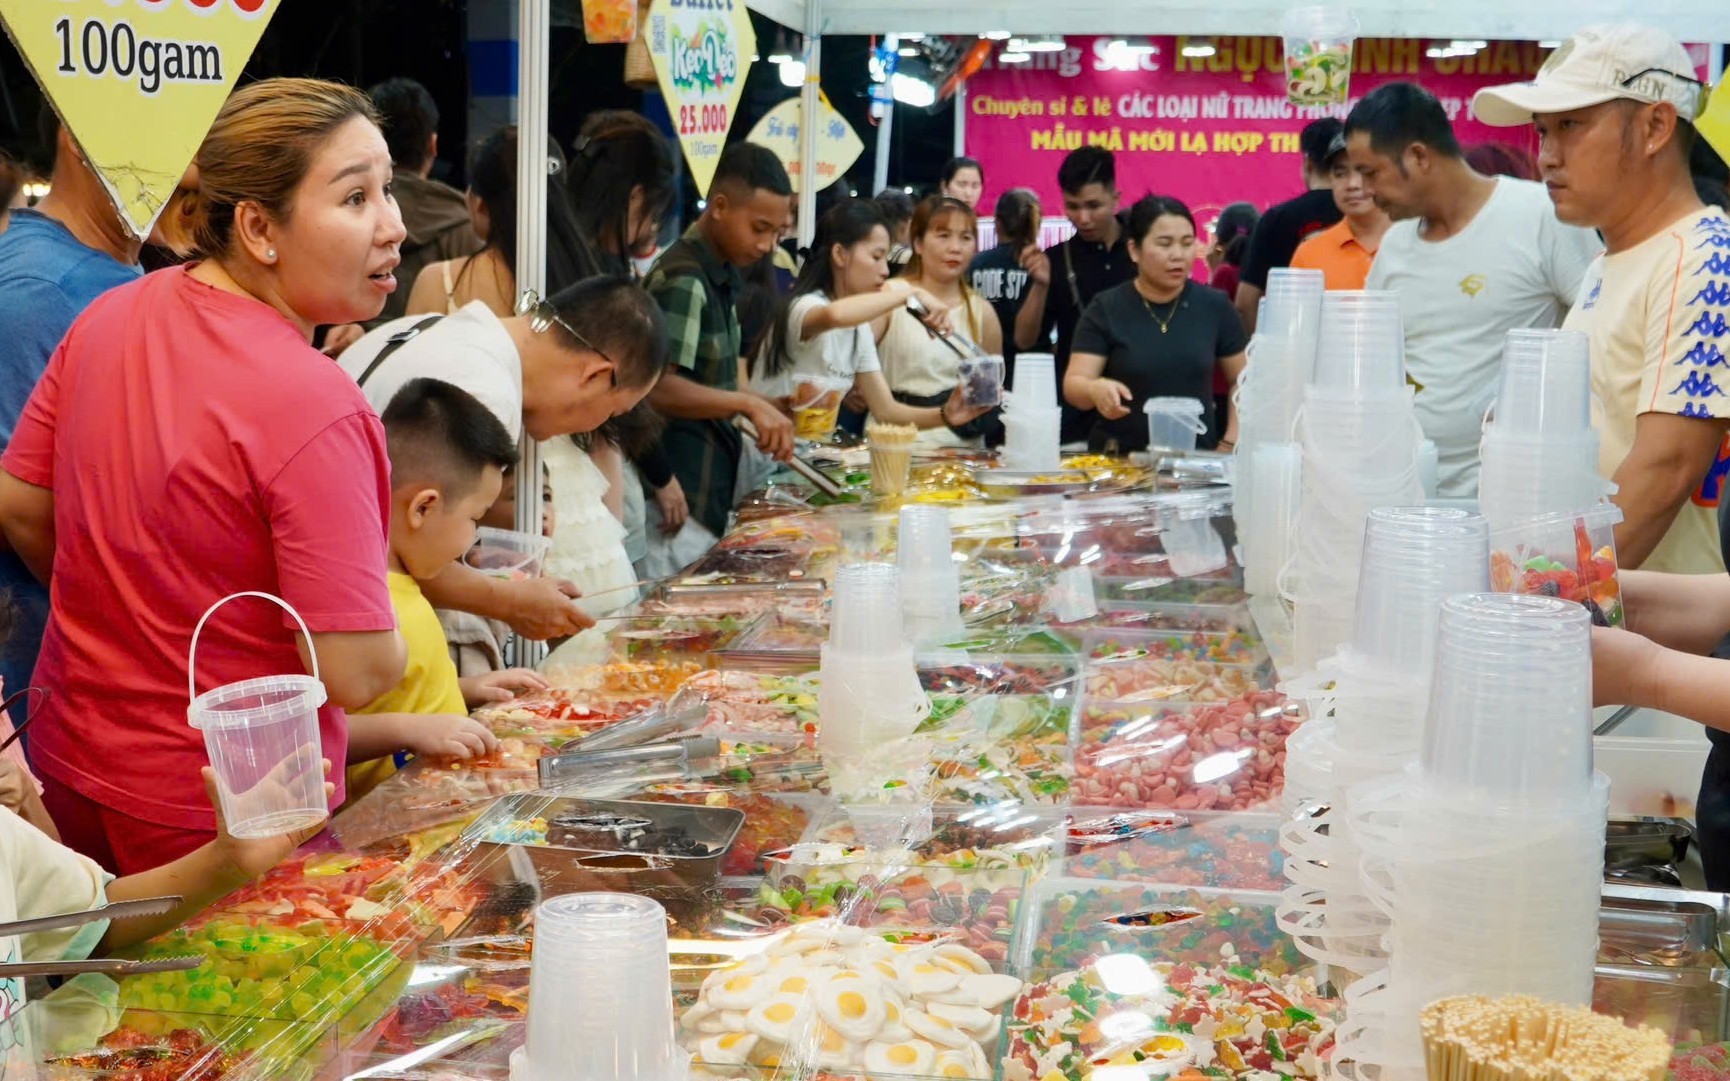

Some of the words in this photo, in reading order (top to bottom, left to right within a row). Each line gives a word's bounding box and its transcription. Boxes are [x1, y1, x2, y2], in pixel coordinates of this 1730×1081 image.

[56, 18, 222, 93] 100gam
[680, 104, 727, 134] 25.000
[1071, 97, 1089, 116] &
[1117, 89, 1153, 118] CÁC
[1157, 95, 1198, 122] LOẠI
[1234, 95, 1292, 119] TRANG
